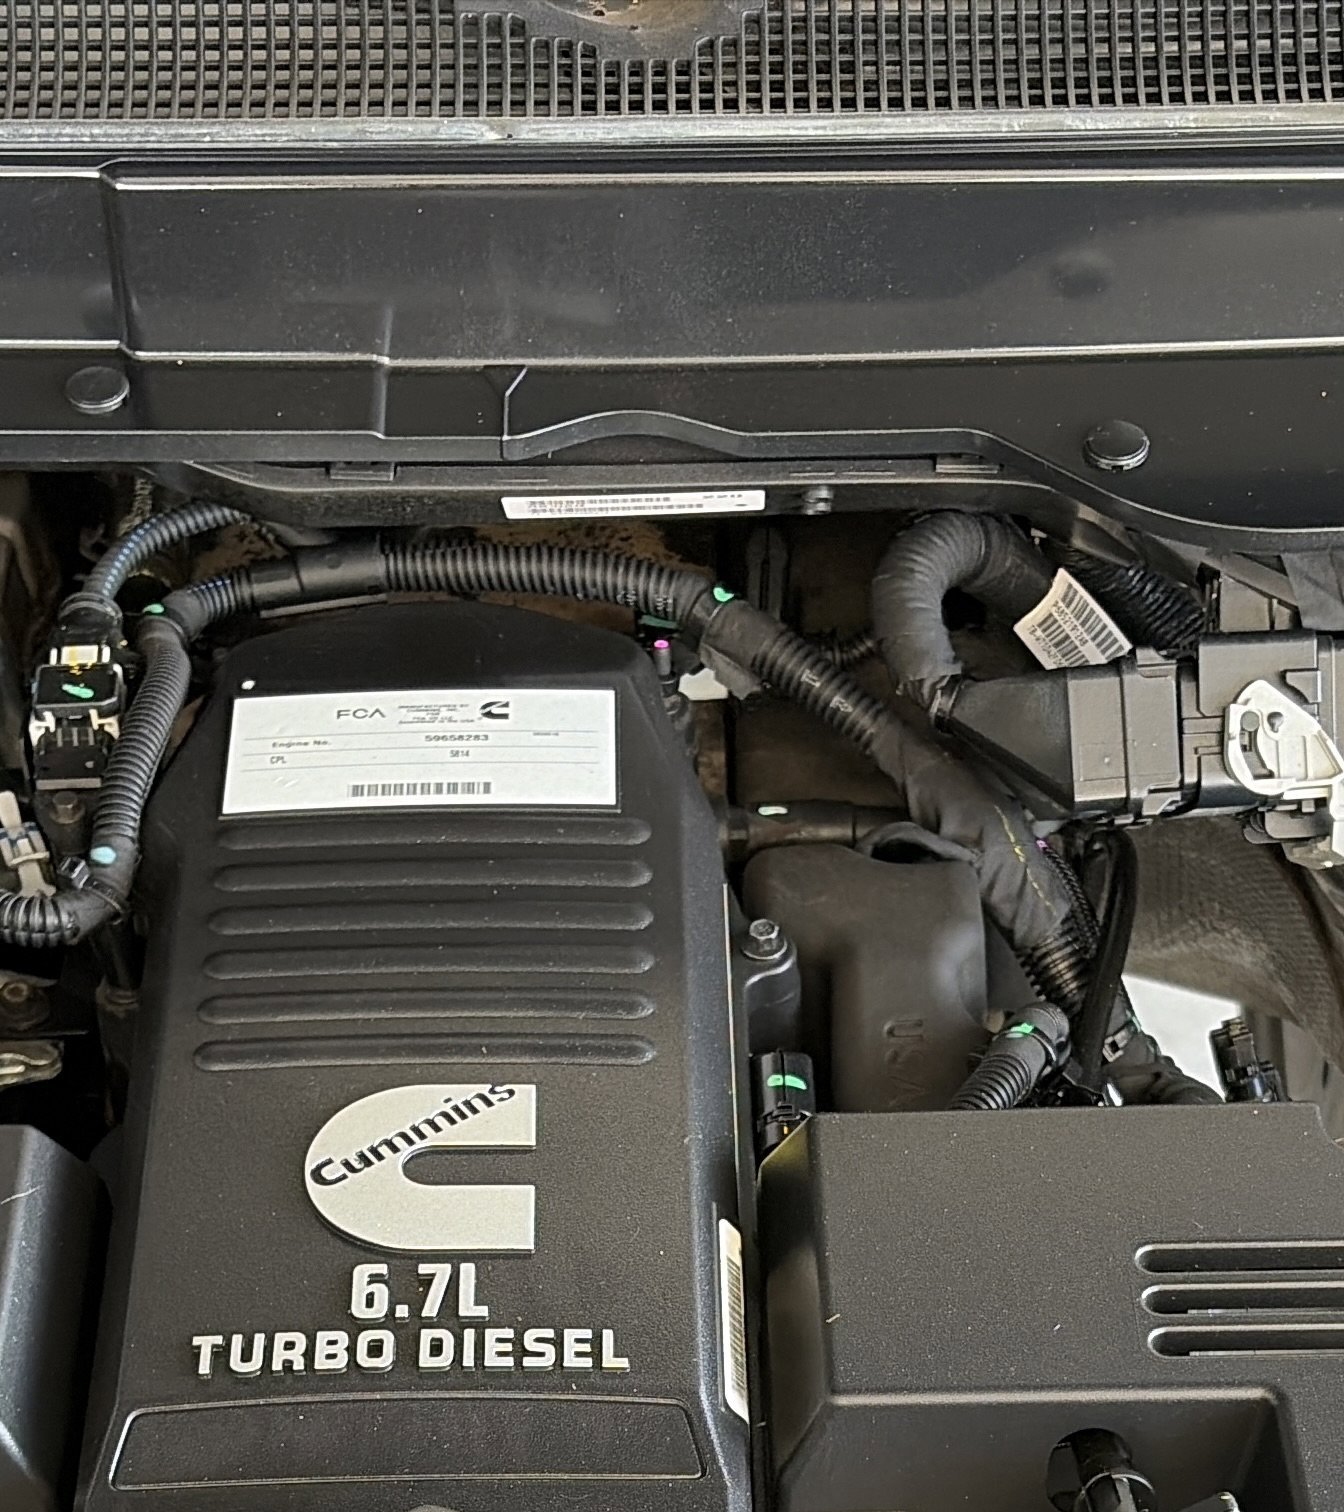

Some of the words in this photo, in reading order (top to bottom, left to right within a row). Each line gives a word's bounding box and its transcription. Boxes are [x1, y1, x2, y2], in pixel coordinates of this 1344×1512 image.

[336, 707, 386, 720] FCA
[270, 755, 287, 764] CPL
[272, 741, 309, 749] Engine
[310, 1083, 516, 1188] Cummins
[350, 1262, 490, 1321] 6.7L
[192, 1329, 397, 1377] TURBO
[418, 1327, 631, 1372] DIESEL
